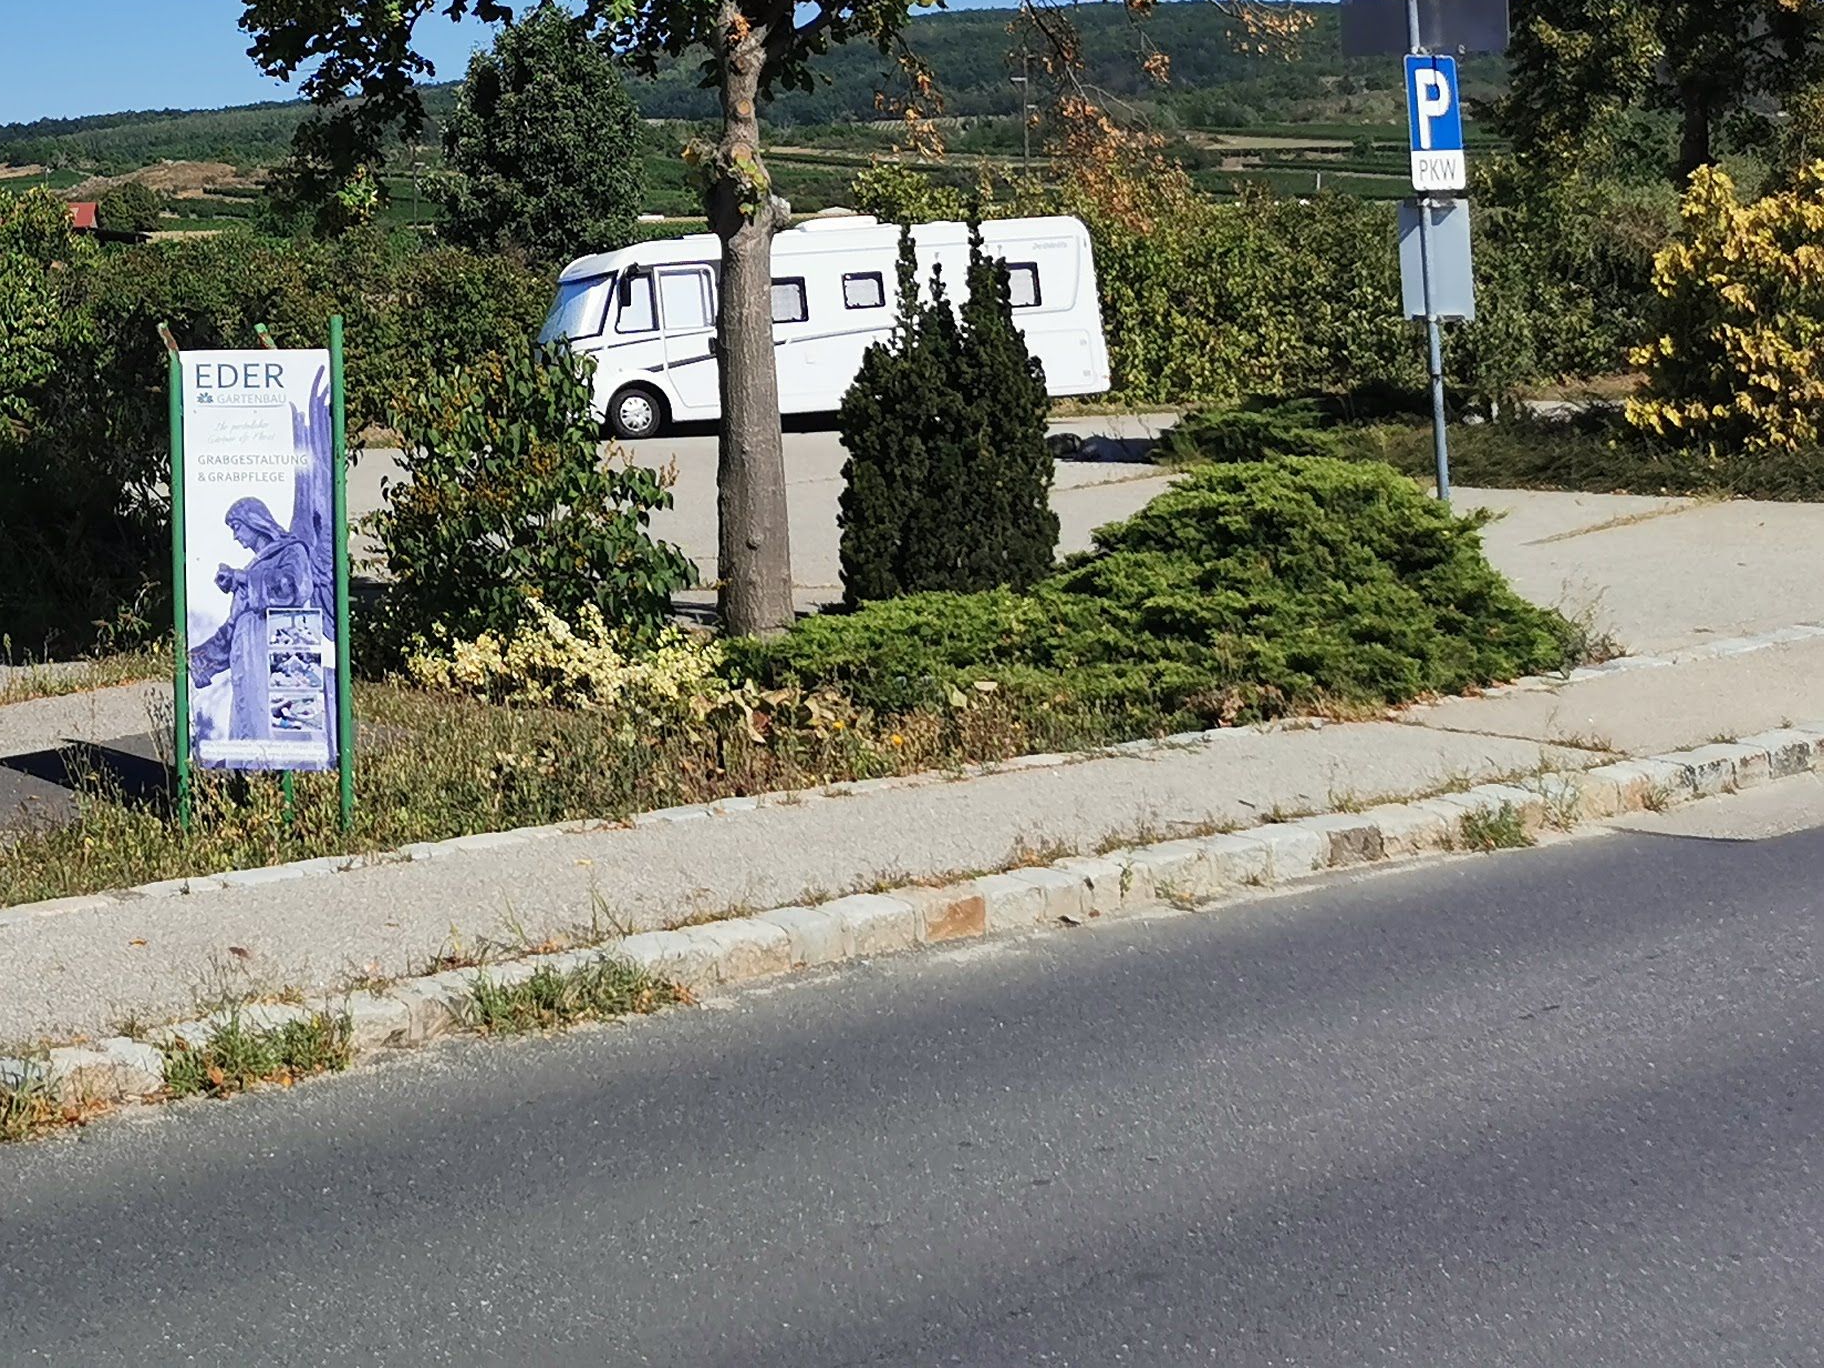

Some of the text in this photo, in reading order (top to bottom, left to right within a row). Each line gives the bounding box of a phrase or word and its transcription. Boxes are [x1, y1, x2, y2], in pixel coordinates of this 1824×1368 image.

[1414, 68, 1451, 150] P
[1419, 158, 1456, 181] PKW
[196, 363, 285, 389] EDER
[216, 393, 287, 404] GARTENBAU
[197, 454, 308, 465] GRABGESTALTUNG
[197, 471, 285, 482] & GRABPFLEGE
